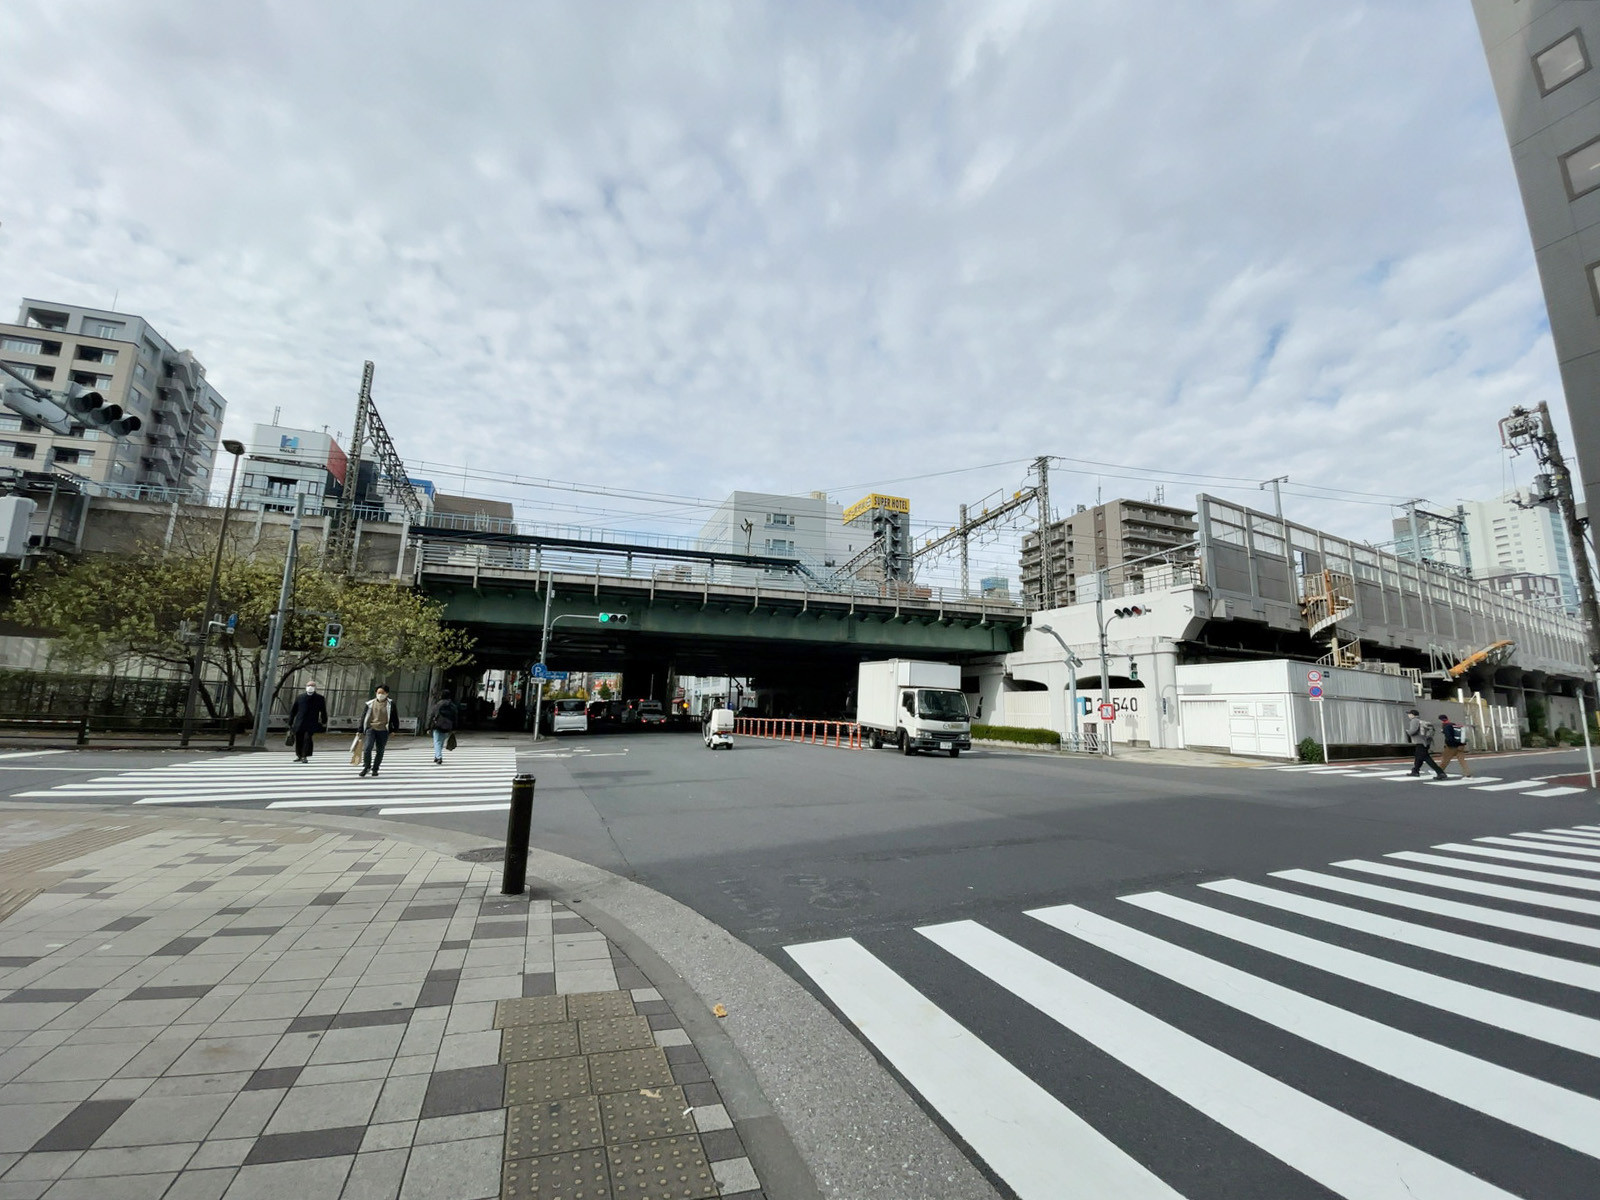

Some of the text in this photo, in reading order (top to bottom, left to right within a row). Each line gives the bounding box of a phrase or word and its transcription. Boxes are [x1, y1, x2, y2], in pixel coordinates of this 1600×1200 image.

[874, 496, 908, 510] SUPER HOTEL
[535, 666, 542, 676] P
